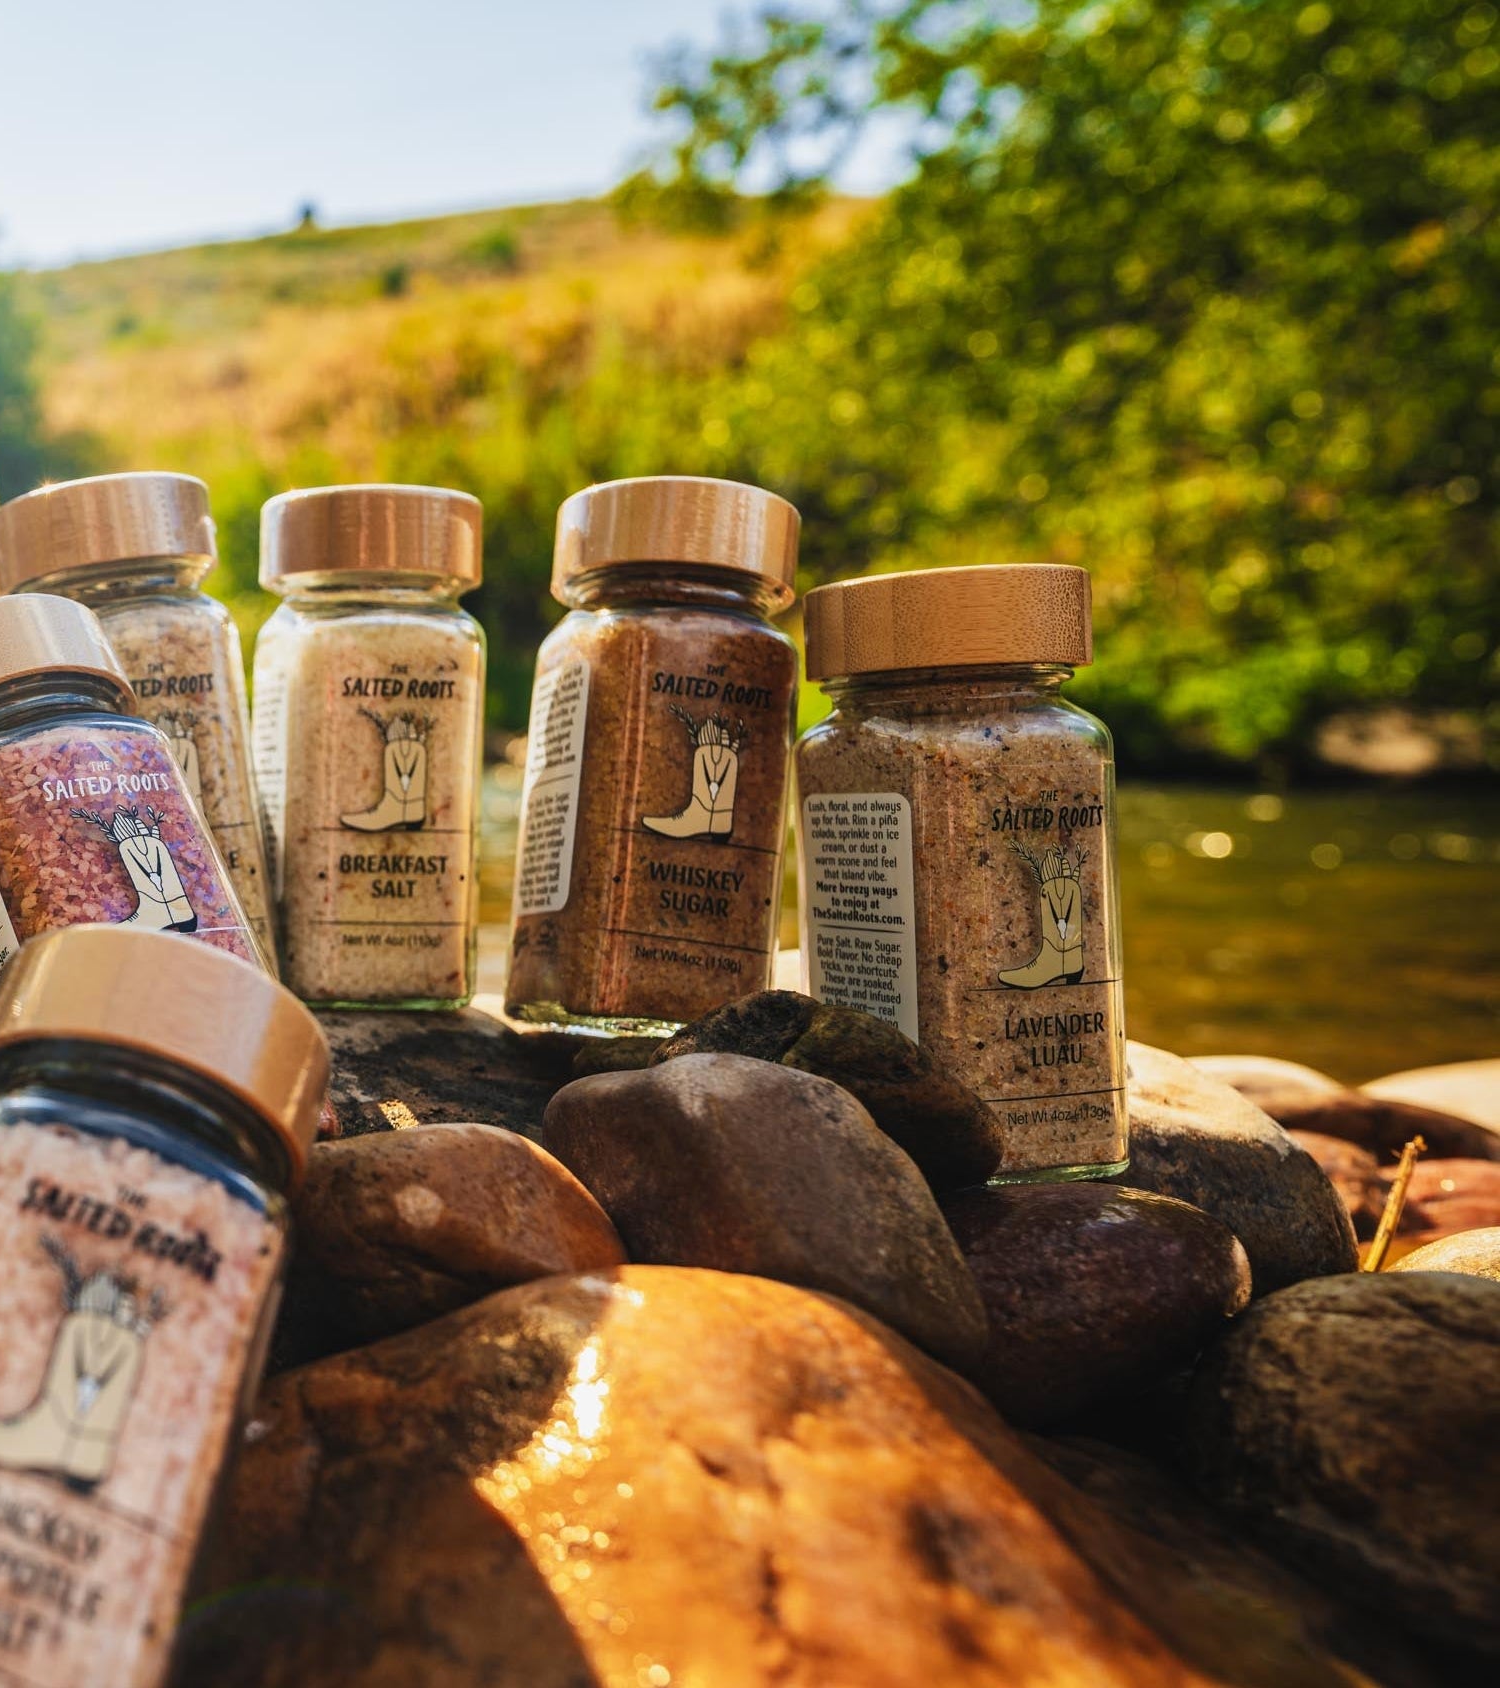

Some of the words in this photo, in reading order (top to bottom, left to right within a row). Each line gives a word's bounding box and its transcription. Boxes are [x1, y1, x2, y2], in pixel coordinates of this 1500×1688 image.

[707, 664, 728, 677] THE
[130, 679, 164, 698] TED
[166, 673, 214, 696] ROOTS
[342, 676, 404, 699] SALTED
[407, 678, 455, 699] ROOTS
[652, 671, 718, 698] SALTED
[721, 682, 773, 709] ROOTS
[91, 760, 111, 772] THE
[42, 776, 112, 802] SALTED
[118, 772, 170, 794] ROOTS
[1041, 790, 1059, 802] THE
[853, 801, 867, 811] and
[870, 801, 901, 814] always
[811, 816, 821, 827] up
[823, 814, 833, 825] for
[852, 814, 868, 825] Rim
[871, 817, 876, 825] a
[879, 815, 898, 828] piña
[992, 808, 1053, 832] SALTED
[1059, 805, 1103, 831] ROOTS
[839, 829, 870, 842] sprinkle
[873, 830, 883, 840] on
[886, 829, 899, 840] ice
[822, 843, 846, 853] cream,
[848, 844, 857, 853] or
[860, 843, 878, 853] dust
[881, 845, 887, 853] a
[339, 854, 448, 875] BREAKFAST
[815, 857, 836, 866] warm
[838, 857, 860, 867] scone
[863, 857, 878, 867] and
[881, 857, 897, 868] feel
[650, 861, 745, 893] WHISKEY
[824, 869, 839, 879] that
[842, 869, 865, 881] island
[868, 870, 887, 882] vibe.
[371, 879, 417, 899] SALT
[816, 881, 837, 893] More
[840, 883, 870, 898] breezy
[872, 886, 898, 899] ways
[660, 889, 728, 918] SUGAR
[831, 896, 840, 907] to
[843, 896, 867, 912] enjoy
[870, 900, 879, 909] at
[813, 907, 906, 926] TheSaltedRoots.com.
[635, 946, 656, 960] Net
[817, 934, 833, 946] Pure
[836, 936, 852, 948] Salt.
[855, 938, 872, 950] Raw
[875, 940, 901, 955] Sugar.
[818, 946, 833, 958] Bold
[835, 949, 859, 961] Flavor.
[862, 952, 873, 963] No
[876, 953, 902, 969] cheap
[825, 971, 845, 985] These
[848, 977, 860, 986] are
[863, 978, 894, 991] soaked,
[845, 965, 854, 973] no
[857, 966, 899, 979] shortcuts.
[852, 990, 867, 999] and
[870, 990, 901, 1004] infused
[879, 1006, 895, 1016] real
[1005, 1012, 1105, 1039] LAVENDER
[1032, 1043, 1083, 1067] LUAU
[1008, 1112, 1028, 1125] Net
[1032, 1111, 1047, 1123] Wt
[1051, 1110, 1071, 1122] 4oz
[20, 1177, 132, 1239] SALTED
